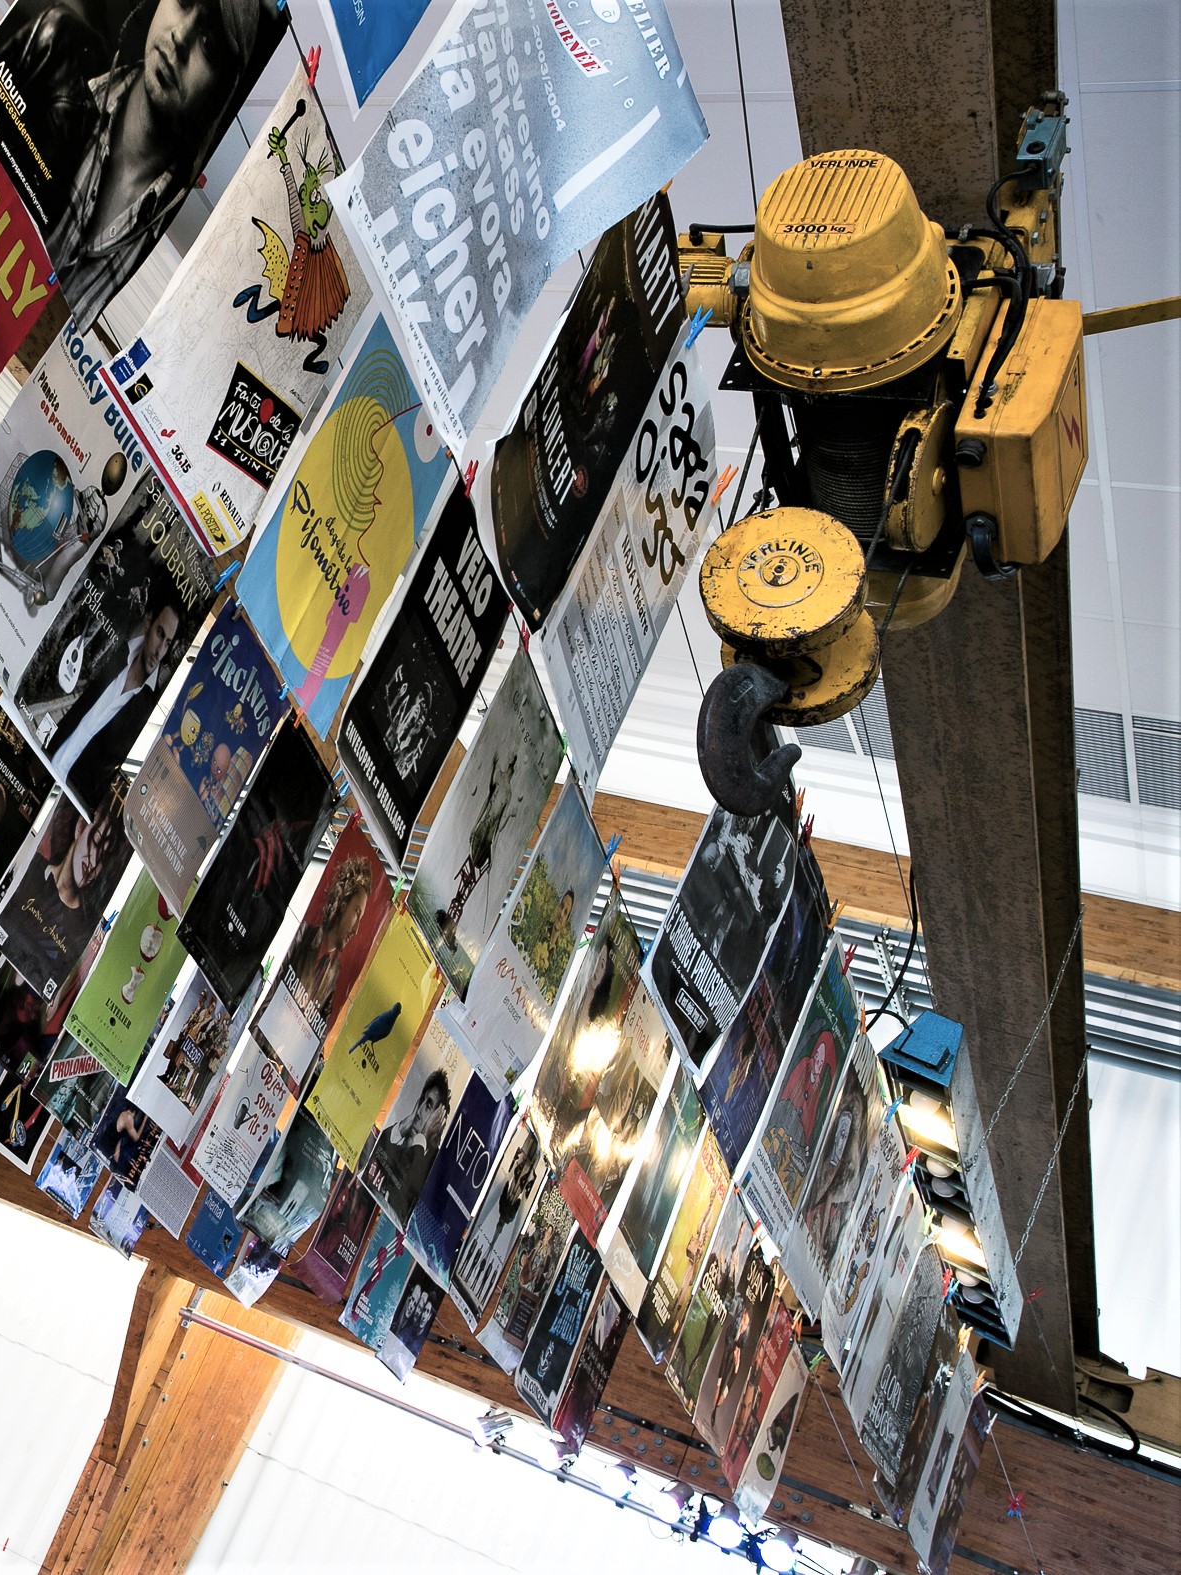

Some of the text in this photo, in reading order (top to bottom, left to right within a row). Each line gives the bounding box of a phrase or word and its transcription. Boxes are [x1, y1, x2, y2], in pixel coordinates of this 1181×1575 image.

[532, 26, 567, 131] 2003/2004
[360, 213, 375, 231] 02
[369, 233, 383, 250] 37
[387, 118, 488, 361] eicher
[463, 128, 513, 316] evora
[782, 224, 846, 234] 3000 kg
[378, 253, 392, 270] 42
[385, 272, 400, 290] 60
[393, 292, 408, 309] 18
[233, 381, 263, 412] Faites
[400, 319, 472, 441] www.vernouillet28.fr
[40, 399, 52, 416] en
[170, 444, 193, 474] 36.15
[234, 448, 261, 473] JUIN
[541, 389, 577, 506] CONCERT
[194, 496, 222, 537] LA POSTE
[220, 488, 247, 532] RENAULT
[146, 476, 181, 527] Samir
[184, 537, 211, 600] Wissam
[739, 539, 821, 574] VERLINDE
[141, 512, 198, 611] JOUBRAN
[455, 526, 493, 618] VELO
[621, 534, 635, 588] NADA
[83, 578, 105, 602] oud
[81, 594, 119, 645] Palestine
[423, 556, 483, 689] THEATRE
[345, 718, 376, 783] ENVELOPPES
[377, 782, 407, 841] DEBALLAGES
[137, 804, 153, 821] DU
[144, 795, 193, 859] LA COMPAGNIE
[144, 819, 169, 847] PETIT
[227, 902, 247, 938] L'ATELIER
[670, 911, 713, 992] CABARET
[105, 997, 132, 1032] L'ATELIER
[259, 1063, 287, 1102] Objets
[445, 1113, 491, 1189] NETO
